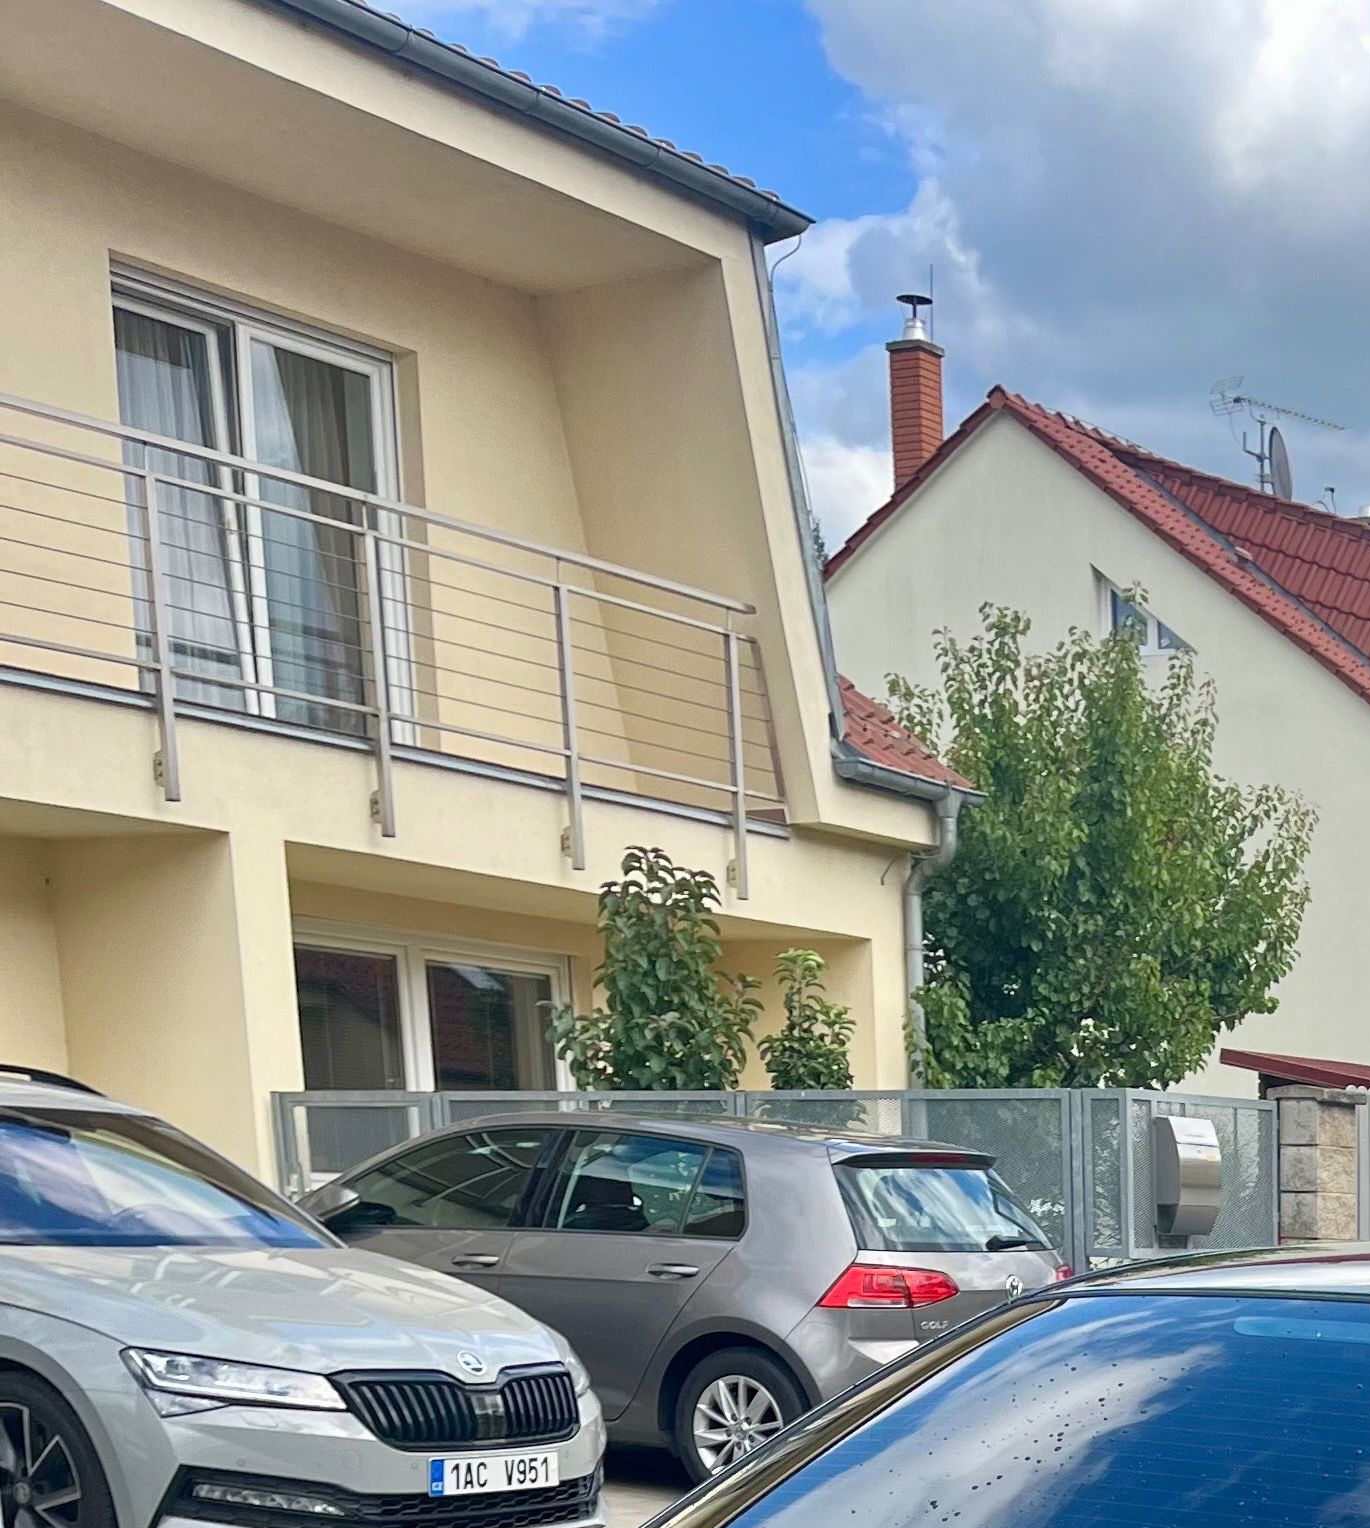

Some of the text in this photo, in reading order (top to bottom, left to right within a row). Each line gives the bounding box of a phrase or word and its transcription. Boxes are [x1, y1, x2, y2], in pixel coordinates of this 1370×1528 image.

[920, 1320, 949, 1330] GOLF
[450, 1456, 549, 1490] 1AC V951
